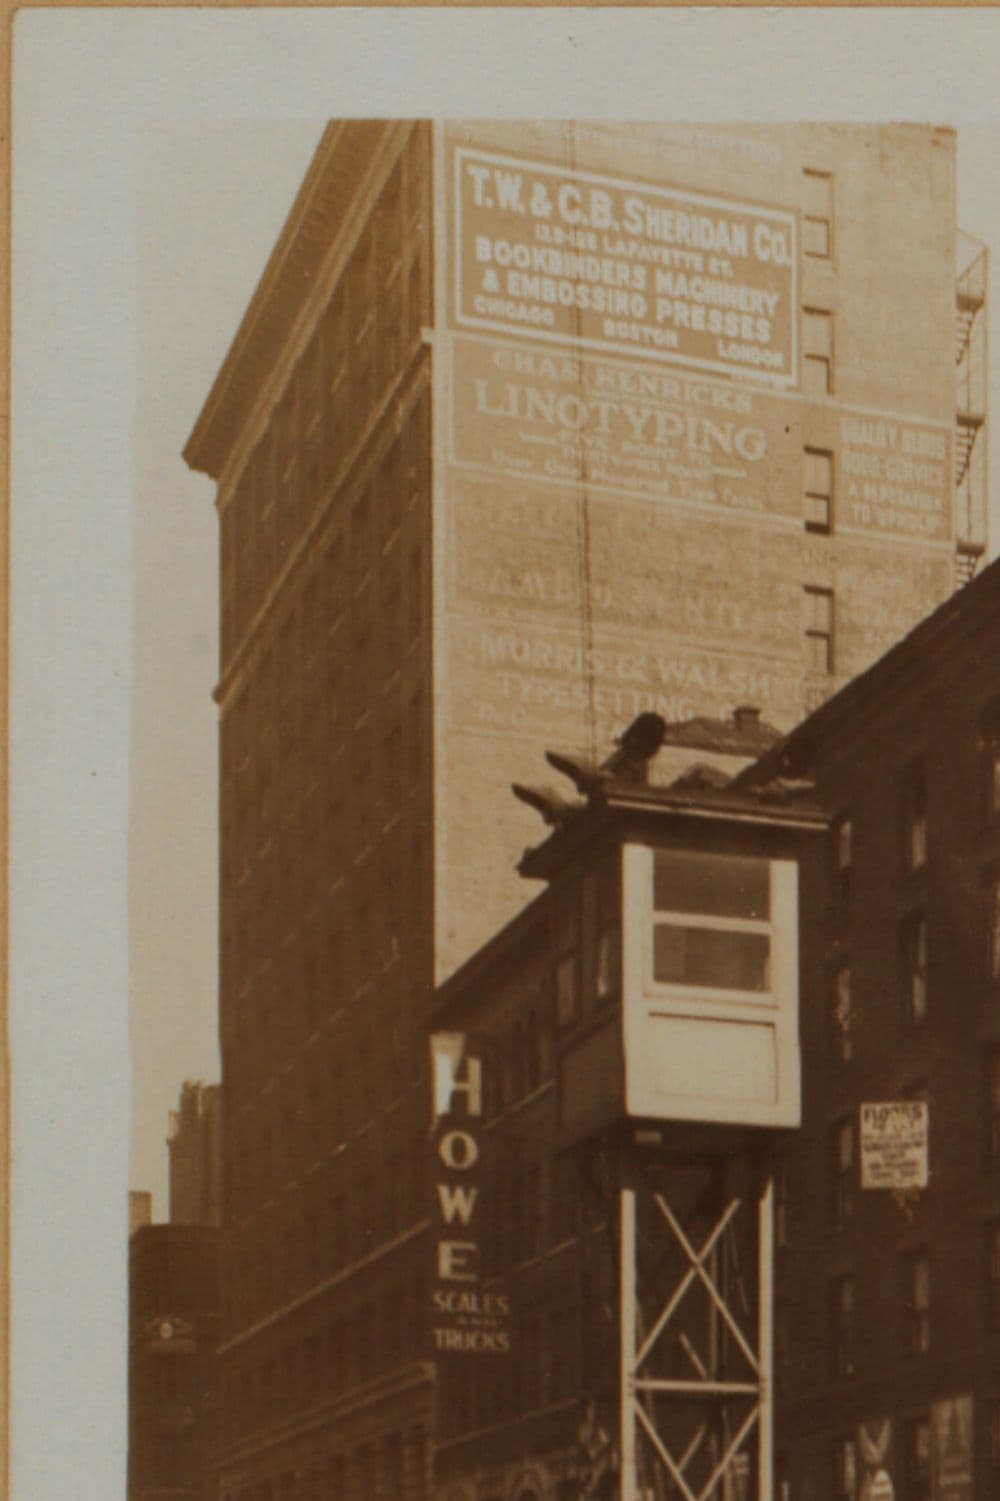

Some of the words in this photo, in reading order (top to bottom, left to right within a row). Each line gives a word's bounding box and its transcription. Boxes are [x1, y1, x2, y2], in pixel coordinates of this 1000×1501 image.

[530, 182, 554, 218] &
[622, 196, 748, 258] SHERIDAN
[475, 233, 647, 291] BOOKBINDERS
[655, 268, 780, 318] MACHINERY
[507, 269, 648, 320] EMBOSSING
[656, 297, 772, 343] PRESSES
[473, 295, 556, 326] CHICAGO
[603, 318, 680, 348] BOSTON
[717, 341, 785, 369] LONDON
[473, 378, 768, 461] LINOTYPING
[432, 1052, 483, 1281] HOWE
